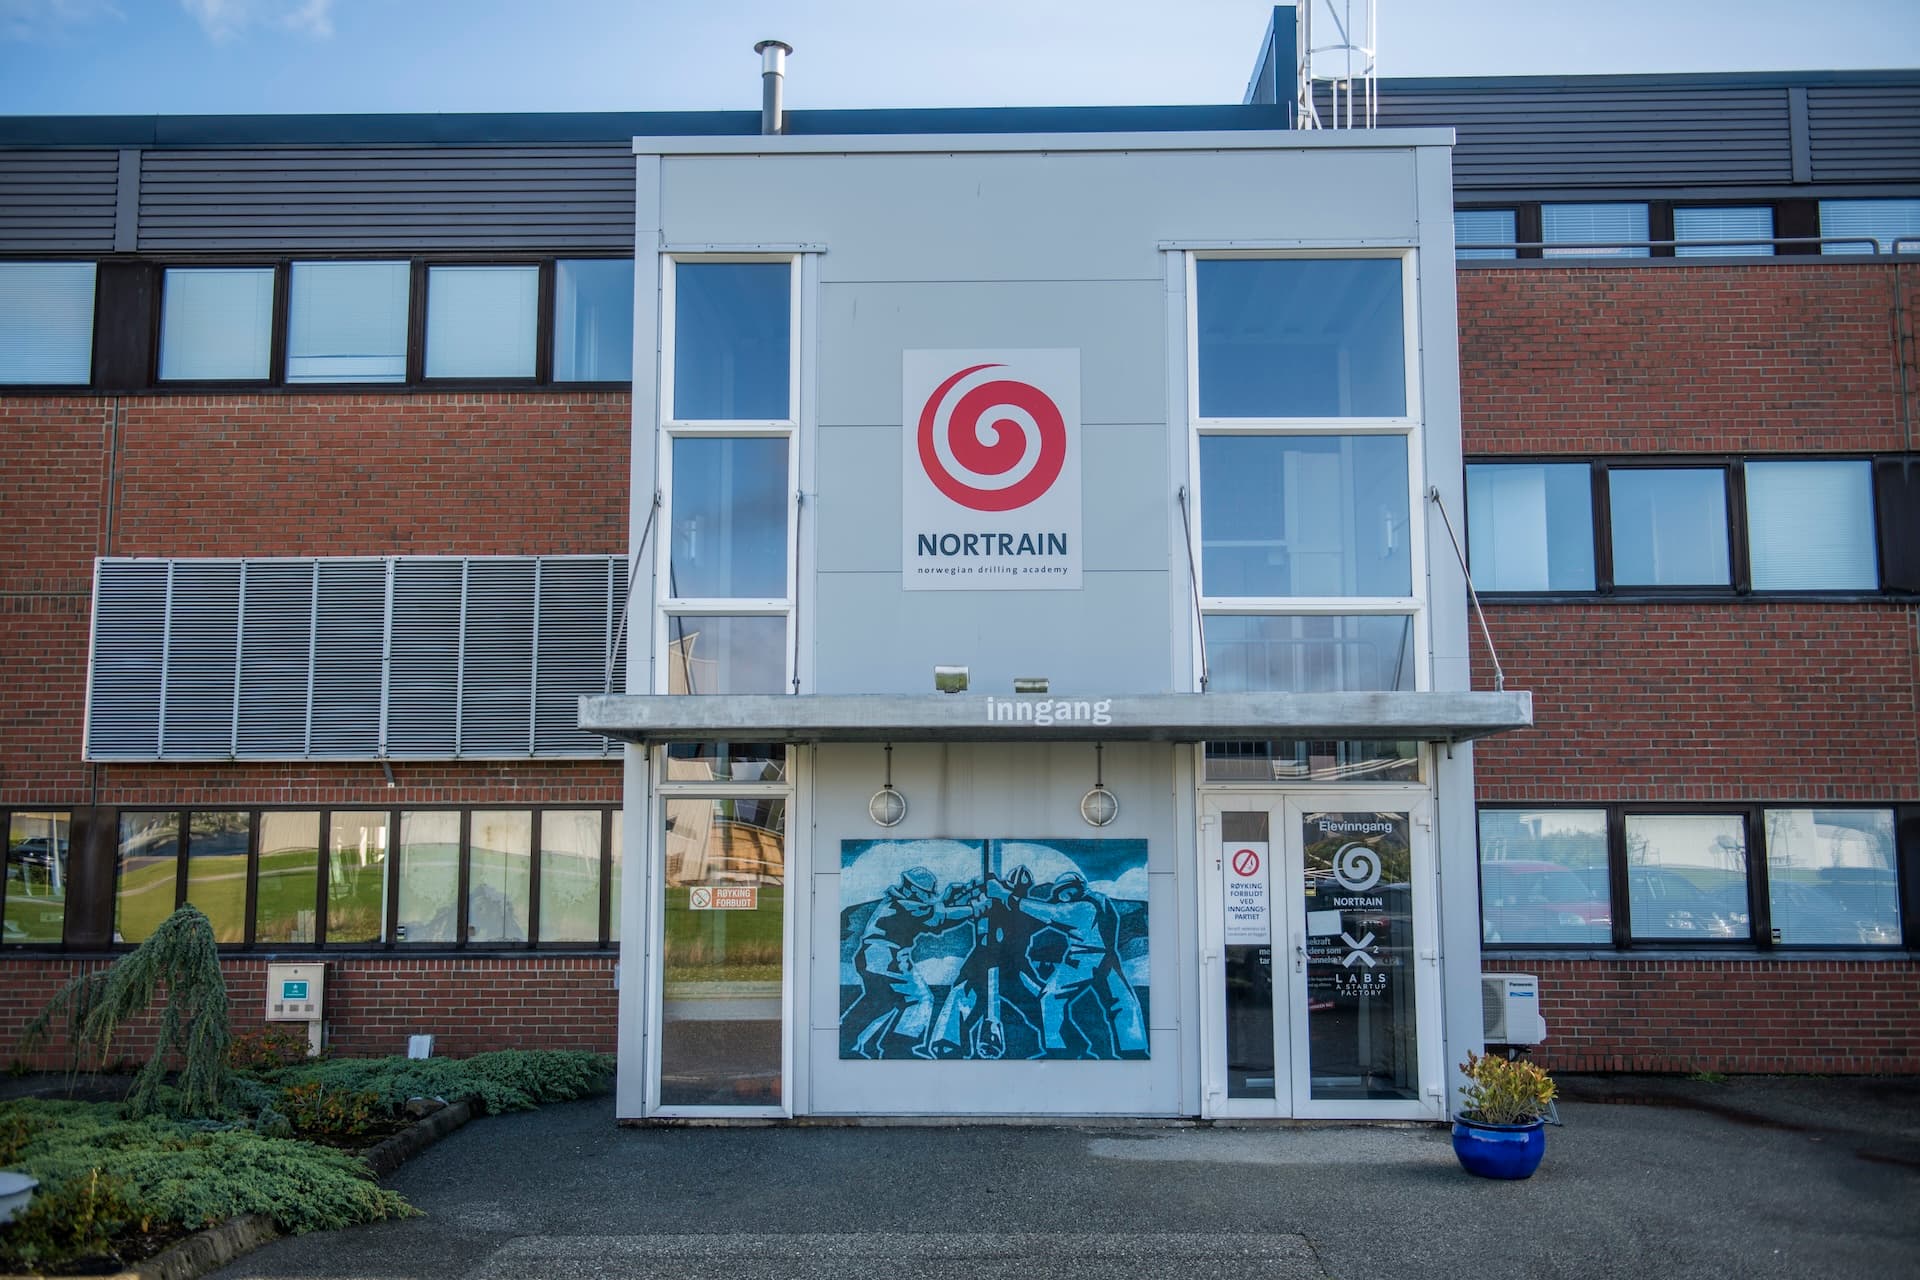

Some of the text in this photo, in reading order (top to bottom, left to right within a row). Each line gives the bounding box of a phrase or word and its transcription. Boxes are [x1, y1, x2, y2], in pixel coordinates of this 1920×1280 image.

[918, 533, 1067, 556] NORTRAIN
[917, 565, 1068, 576] norwegian drilling academy
[987, 697, 1112, 726] inngang
[1319, 821, 1392, 833] Elevinngang
[717, 889, 751, 897] RØYKING
[716, 899, 751, 907] FORBUDT
[1333, 897, 1383, 906] NORTRAIN
[1335, 973, 1386, 983] LABS
